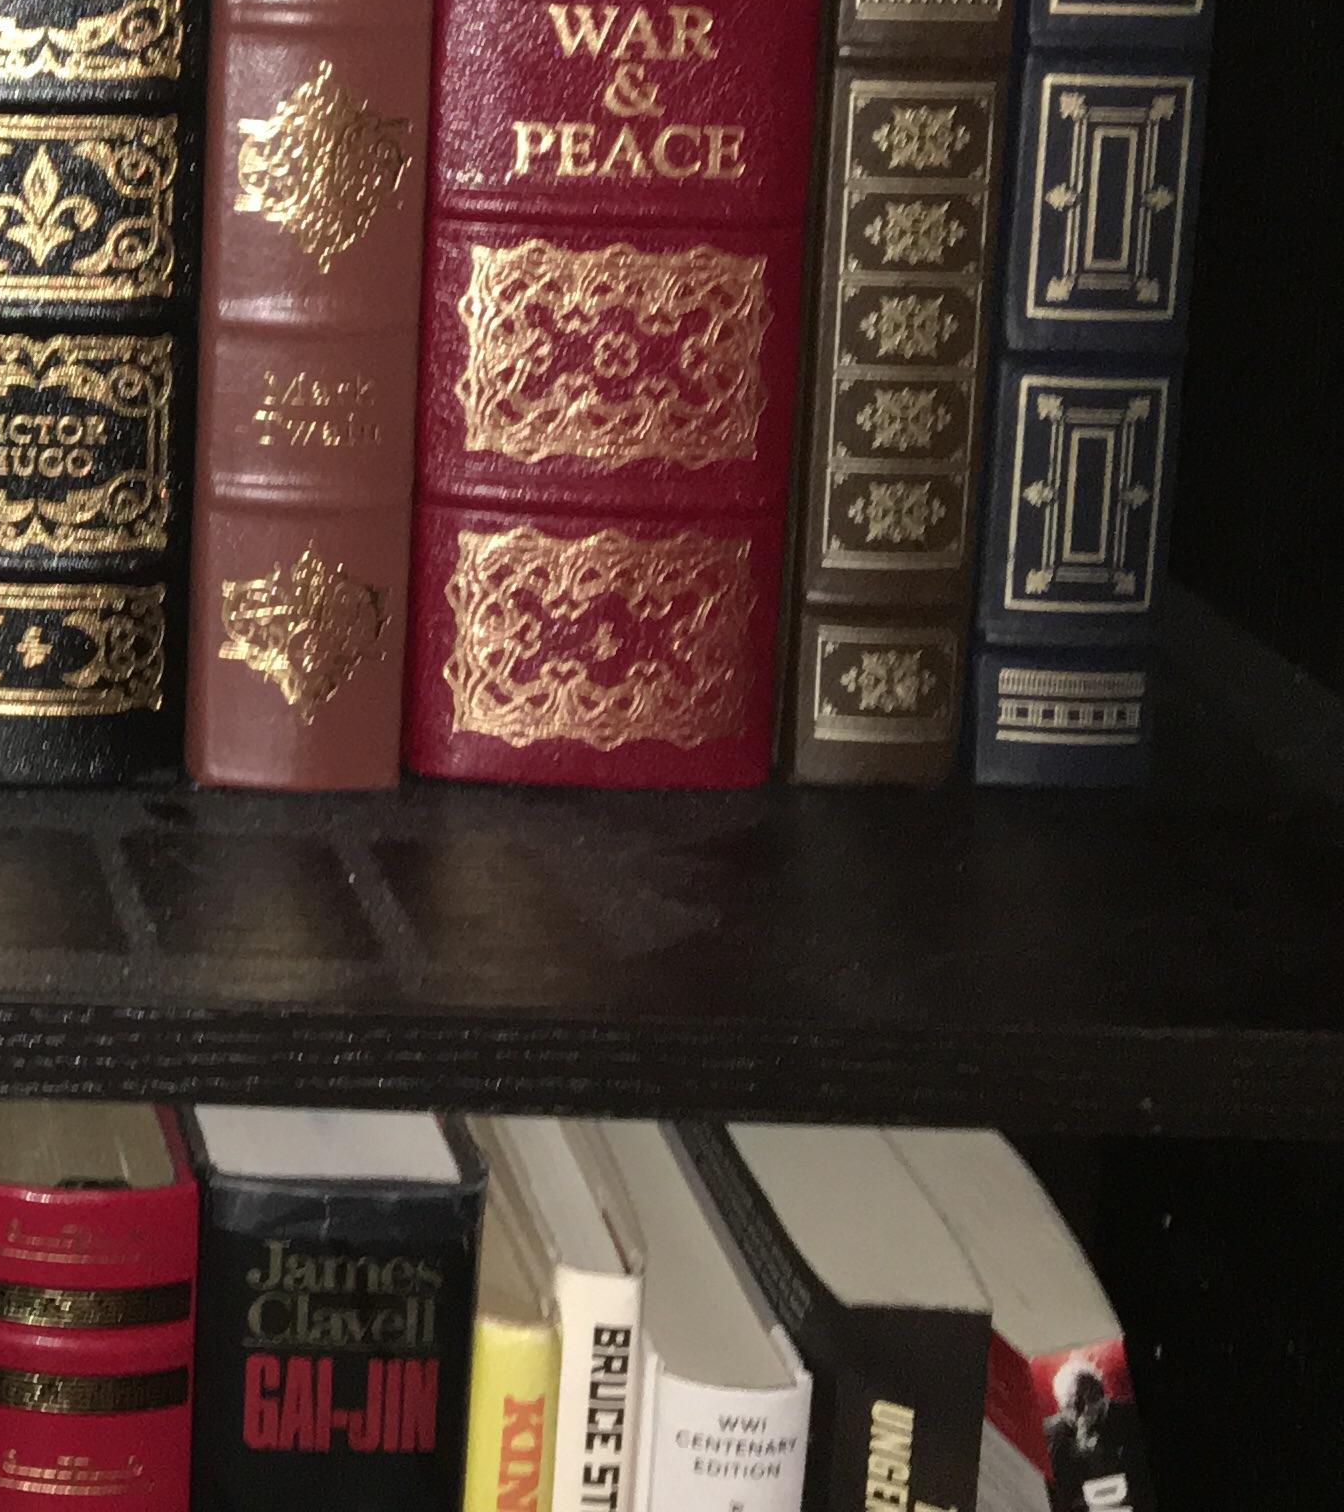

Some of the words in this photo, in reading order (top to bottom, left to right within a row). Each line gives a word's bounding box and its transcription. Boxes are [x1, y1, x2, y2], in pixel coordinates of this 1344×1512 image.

[548, 2, 719, 62] WAR
[602, 63, 665, 117] &
[511, 120, 746, 180] PEACE
[246, 1239, 443, 1290] James
[246, 1290, 435, 1347] Clavell
[242, 1352, 440, 1454] GAI-JIN
[584, 1324, 633, 1455] BRUCE
[674, 1428, 798, 1456] CENTENARY
[693, 1455, 781, 1480] EDITION
